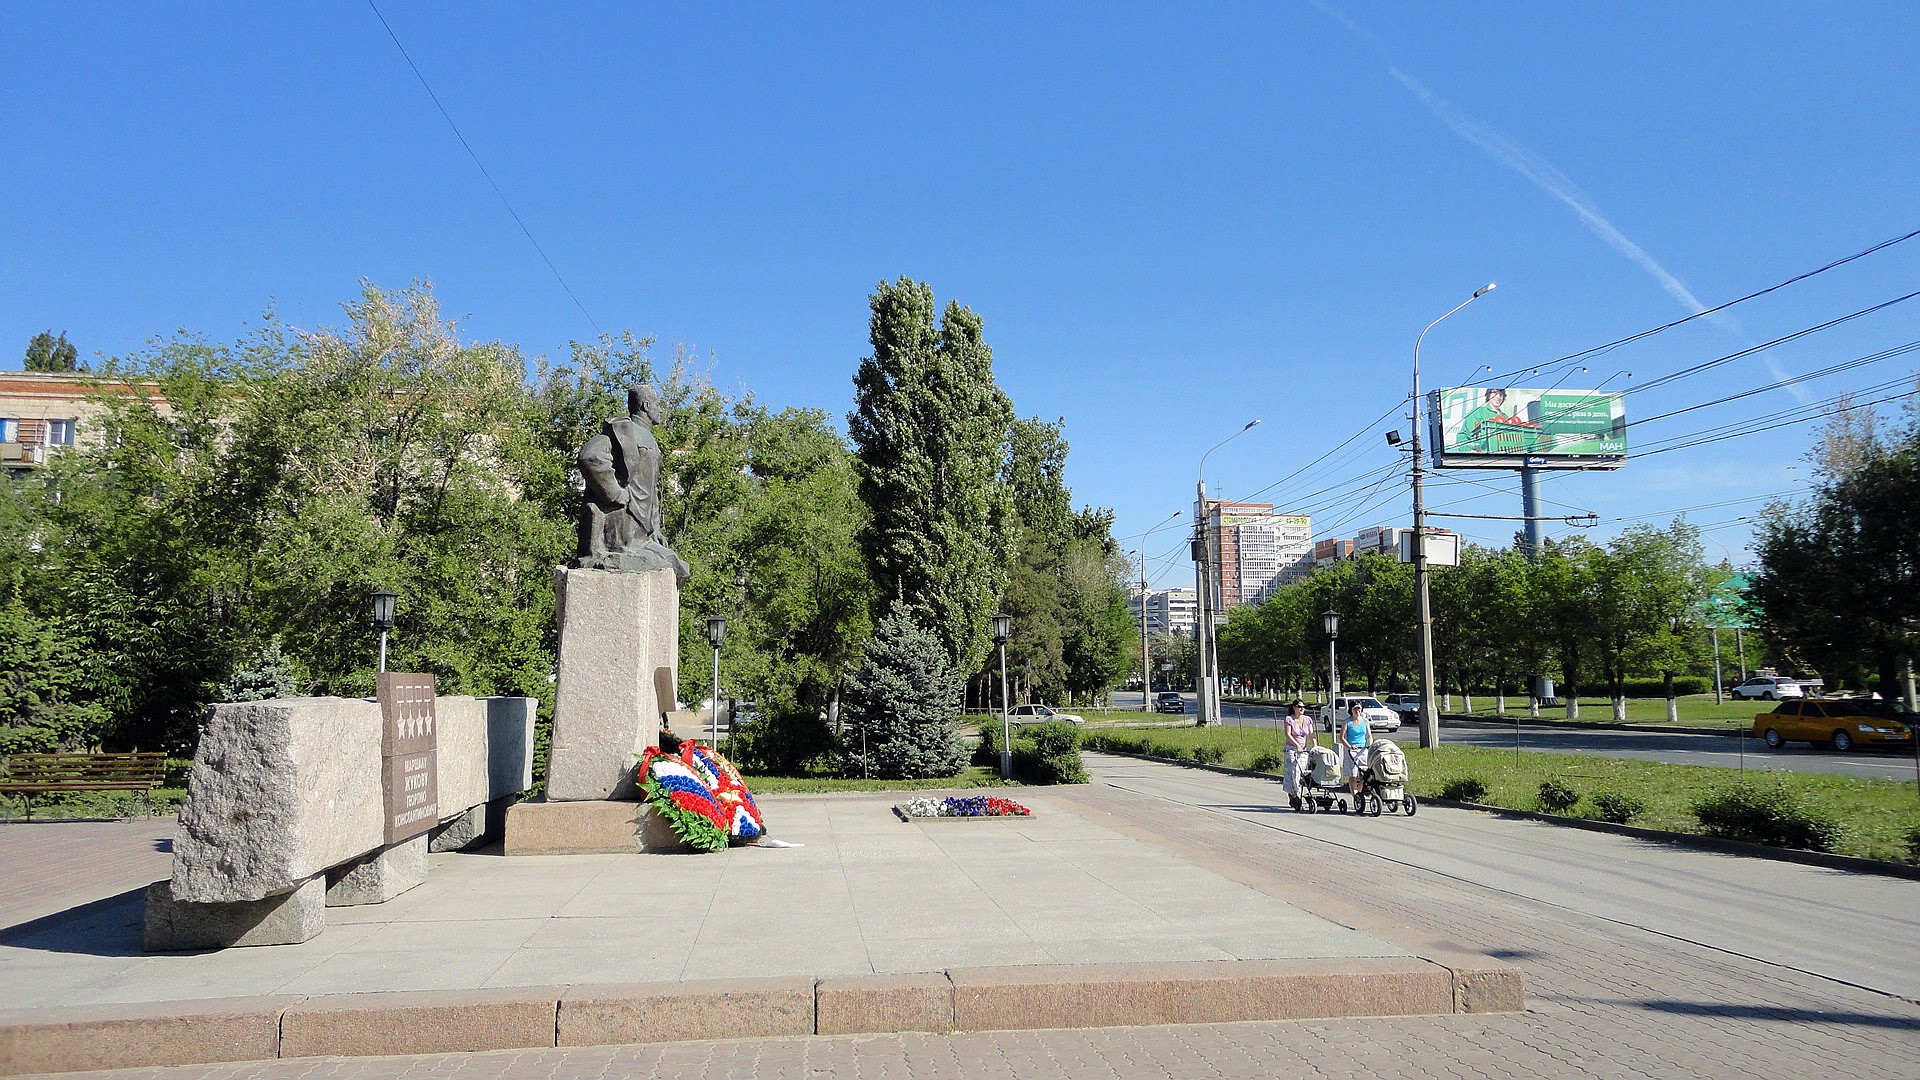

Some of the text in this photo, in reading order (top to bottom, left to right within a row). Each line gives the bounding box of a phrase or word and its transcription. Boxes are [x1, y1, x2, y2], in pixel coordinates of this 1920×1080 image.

[405, 757, 427, 772] МАРШАЛУ
[405, 772, 428, 791] ЖУКОВУ
[407, 791, 427, 807] ГЕОРГИЮ
